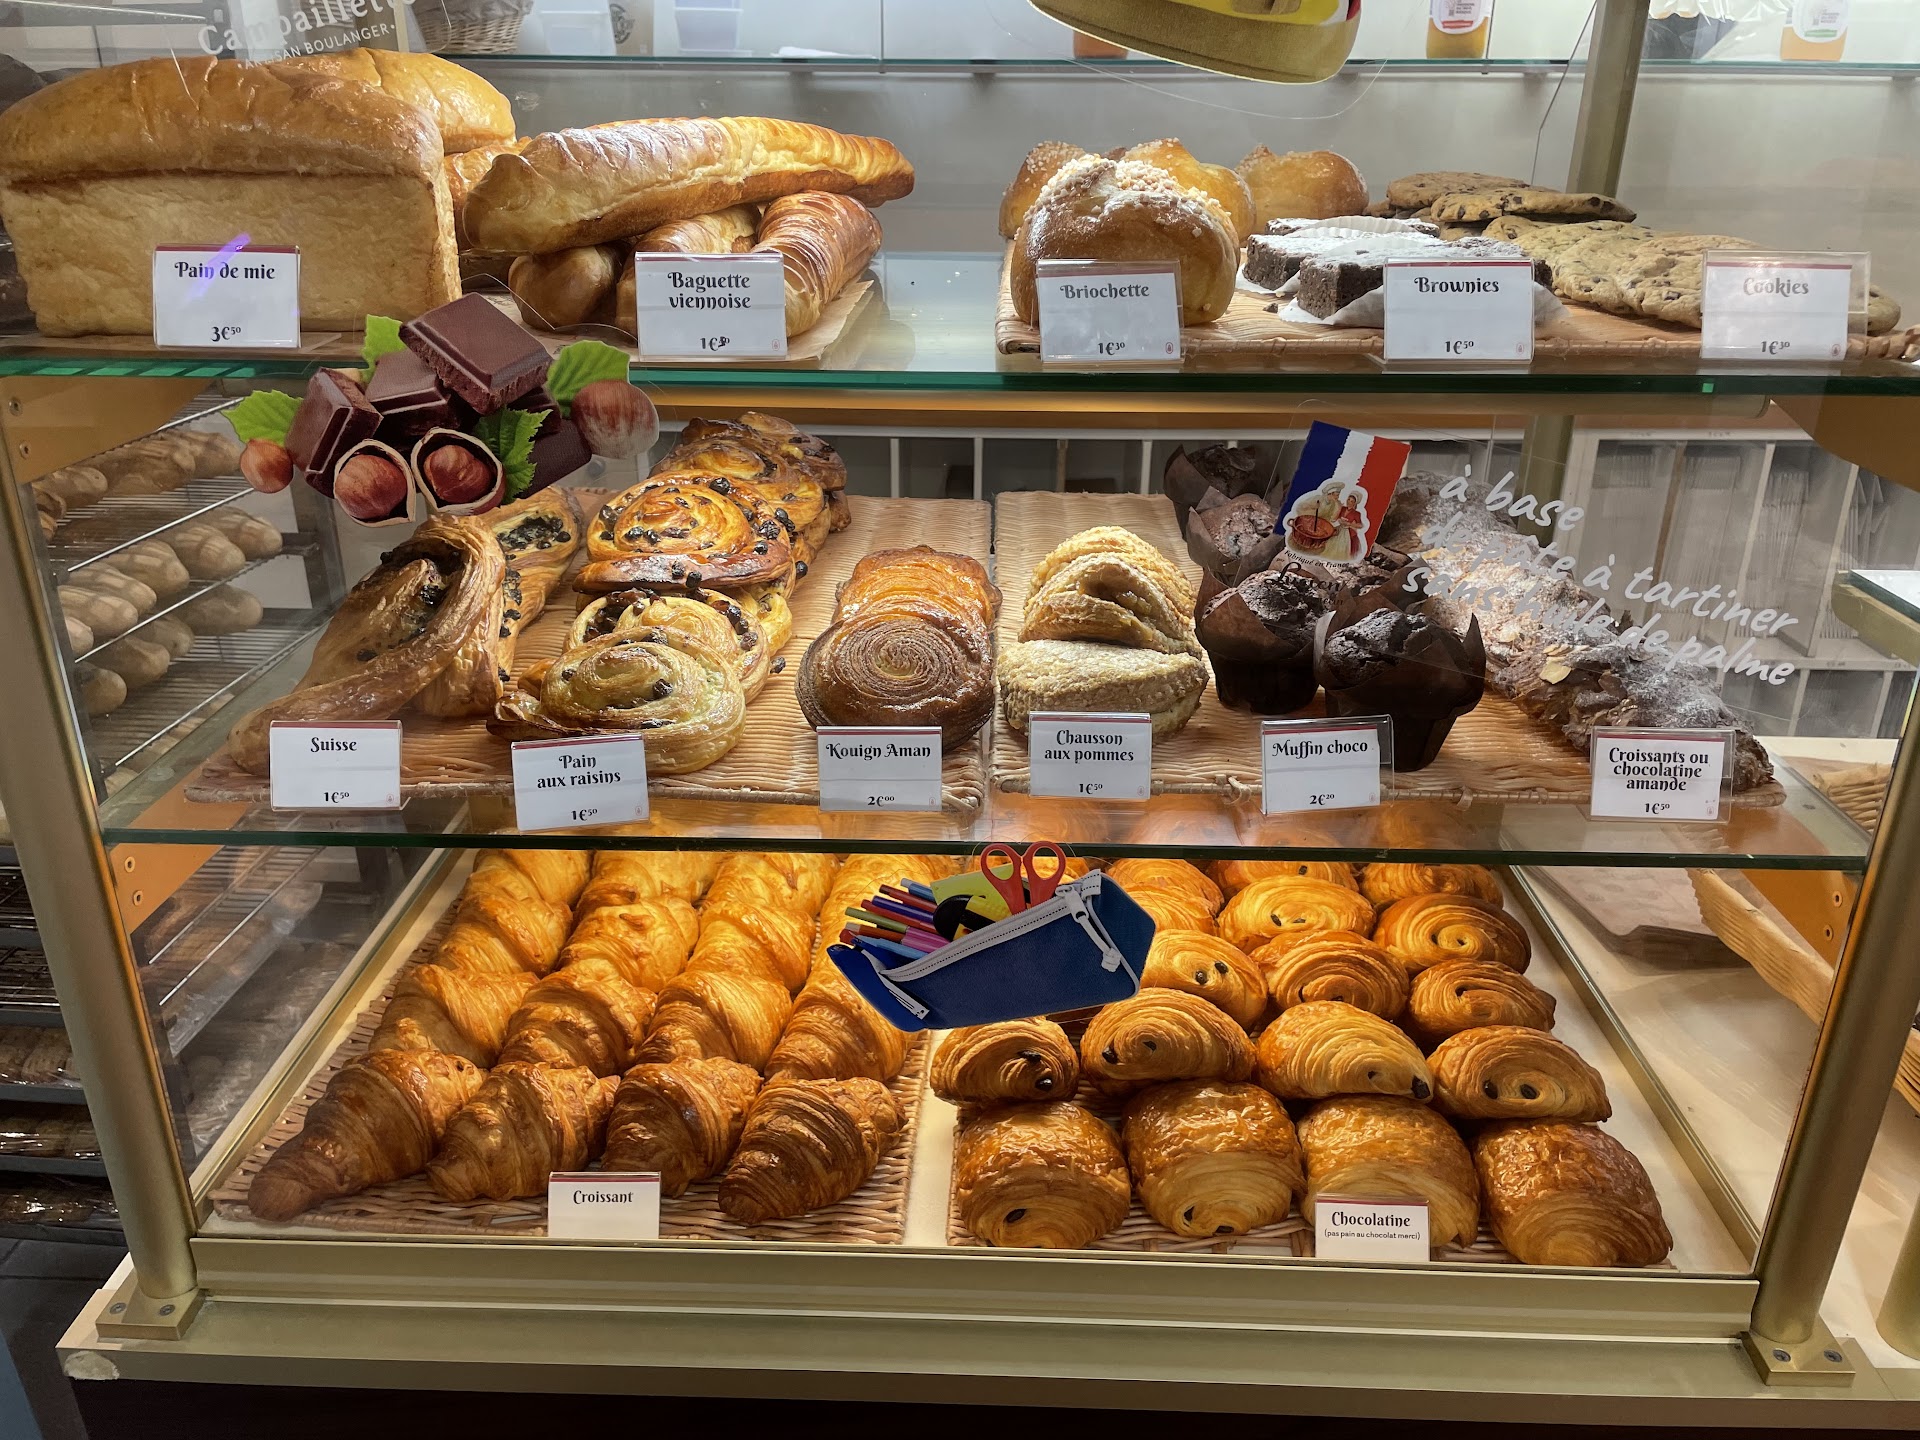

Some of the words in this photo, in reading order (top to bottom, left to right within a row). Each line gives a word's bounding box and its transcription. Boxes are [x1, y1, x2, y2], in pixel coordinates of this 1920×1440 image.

[304, 24, 390, 55] BOULANGER
[174, 262, 215, 280] Pain
[219, 261, 239, 279] de
[244, 264, 276, 280] mie
[667, 271, 751, 293] Baguette
[1413, 276, 1500, 294] Brownies
[1743, 277, 1810, 297] Cookies
[1059, 283, 1150, 299] Briochette
[668, 293, 752, 310] viennoise
[211, 326, 242, 342] 3€50
[1097, 341, 1126, 356] 1€30
[1445, 340, 1475, 355] 1€50
[1760, 340, 1791, 355] 1€30
[1439, 463, 1472, 504] à
[1485, 470, 1585, 532] base
[1284, 550, 1314, 567] Fabriqué
[1420, 510, 1472, 554] de
[1470, 534, 1577, 581] pâte
[1582, 553, 1616, 591] à
[1624, 566, 1799, 634] tartiner
[1401, 566, 1508, 611] sans
[1512, 581, 1613, 638] huile
[1619, 612, 1670, 654] de
[1665, 637, 1797, 686] palme
[310, 736, 358, 753] Suisse
[1056, 729, 1123, 746] Chausson
[825, 742, 882, 761] Kouign
[884, 743, 931, 758] Aman
[1044, 749, 1071, 760] aux
[1074, 750, 1134, 764] pommes
[1272, 739, 1323, 759] Muffin
[1327, 739, 1368, 754] choco
[1609, 747, 1685, 764] Croissants
[1689, 752, 1709, 764] ou
[558, 754, 597, 769] Pain
[1613, 761, 1702, 779] chocolatine
[537, 776, 567, 789] aux
[570, 770, 621, 786] raisins
[1626, 776, 1687, 792] amande
[323, 791, 350, 804] 1€50
[1079, 783, 1103, 795] 1€50
[867, 796, 895, 807] 2€00
[1309, 794, 1335, 806] 2€20
[1644, 802, 1670, 815] 1€50
[571, 808, 598, 822] 1€50
[573, 1189, 634, 1204] Croissant
[1331, 1211, 1411, 1228] Chocolatine
[1324, 1228, 1340, 1238] (pas
[1340, 1230, 1355, 1239] pain
[1366, 1231, 1397, 1239] chocolat
[1397, 1231, 1421, 1240] merci)
